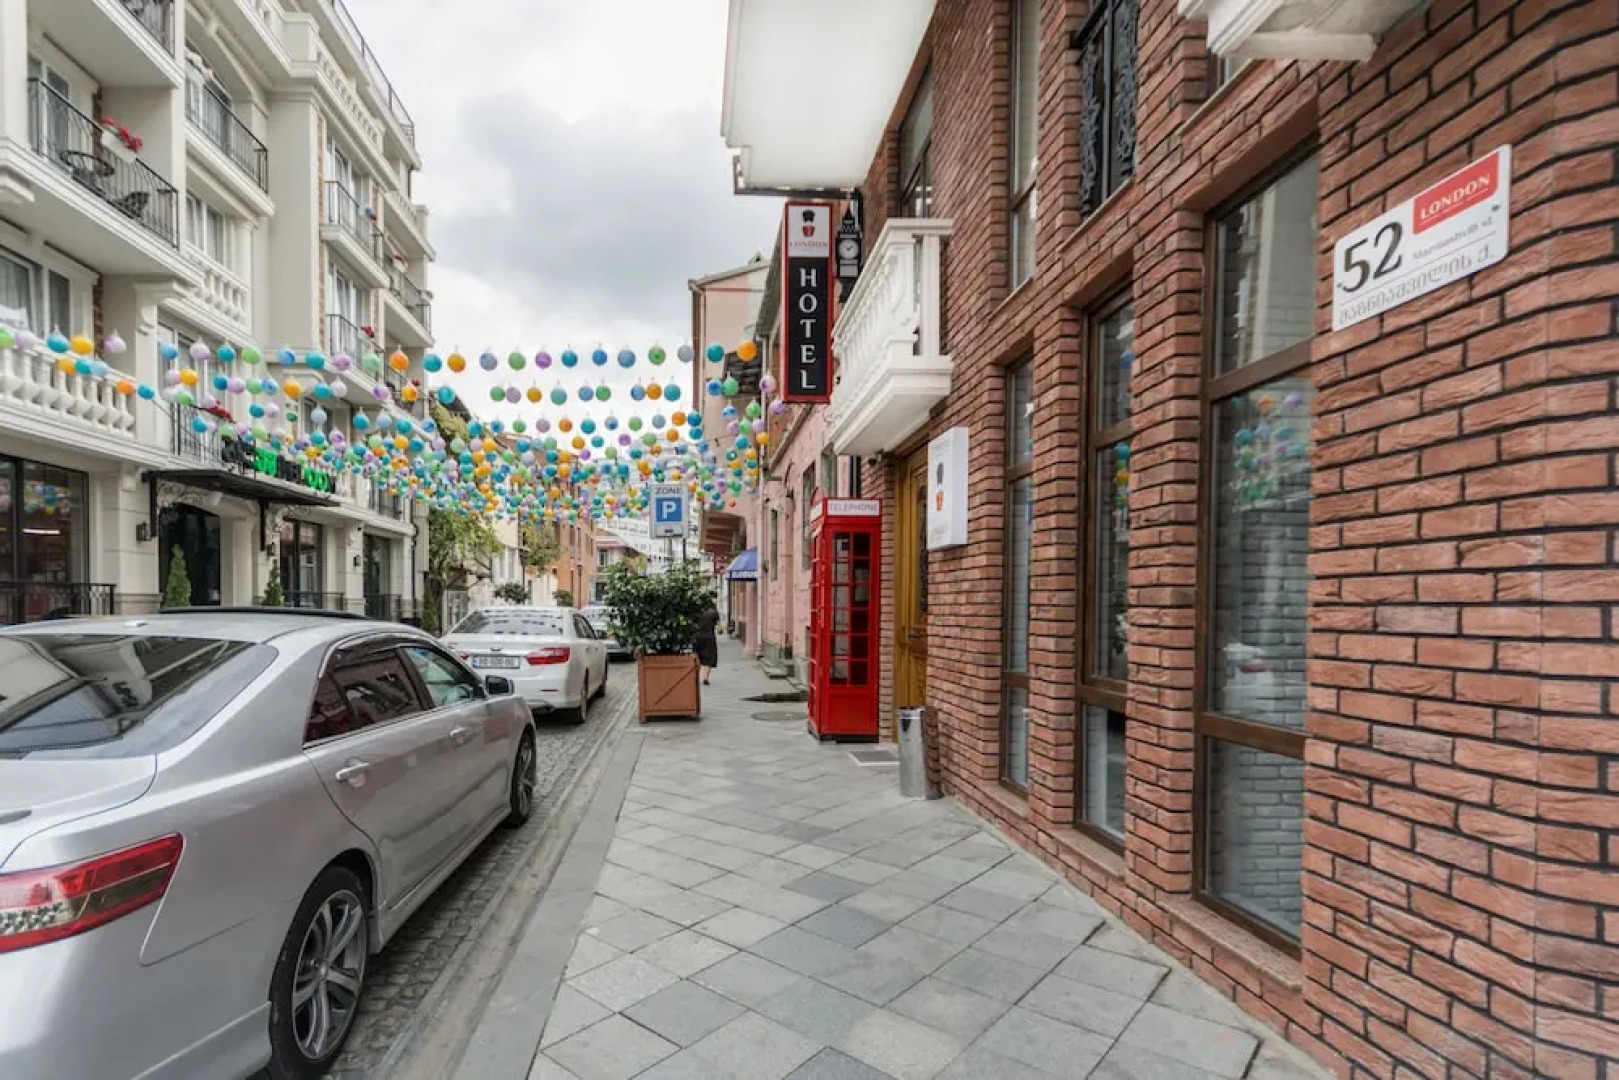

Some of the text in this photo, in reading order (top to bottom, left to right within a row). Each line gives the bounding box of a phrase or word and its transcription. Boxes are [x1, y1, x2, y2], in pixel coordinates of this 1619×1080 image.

[1420, 173, 1490, 220] LONDON
[1343, 222, 1403, 293] 52
[798, 267, 818, 390] HOTEL
[655, 486, 682, 495] ZONE
[661, 501, 677, 519] P
[829, 501, 877, 513] TELEPHONE
